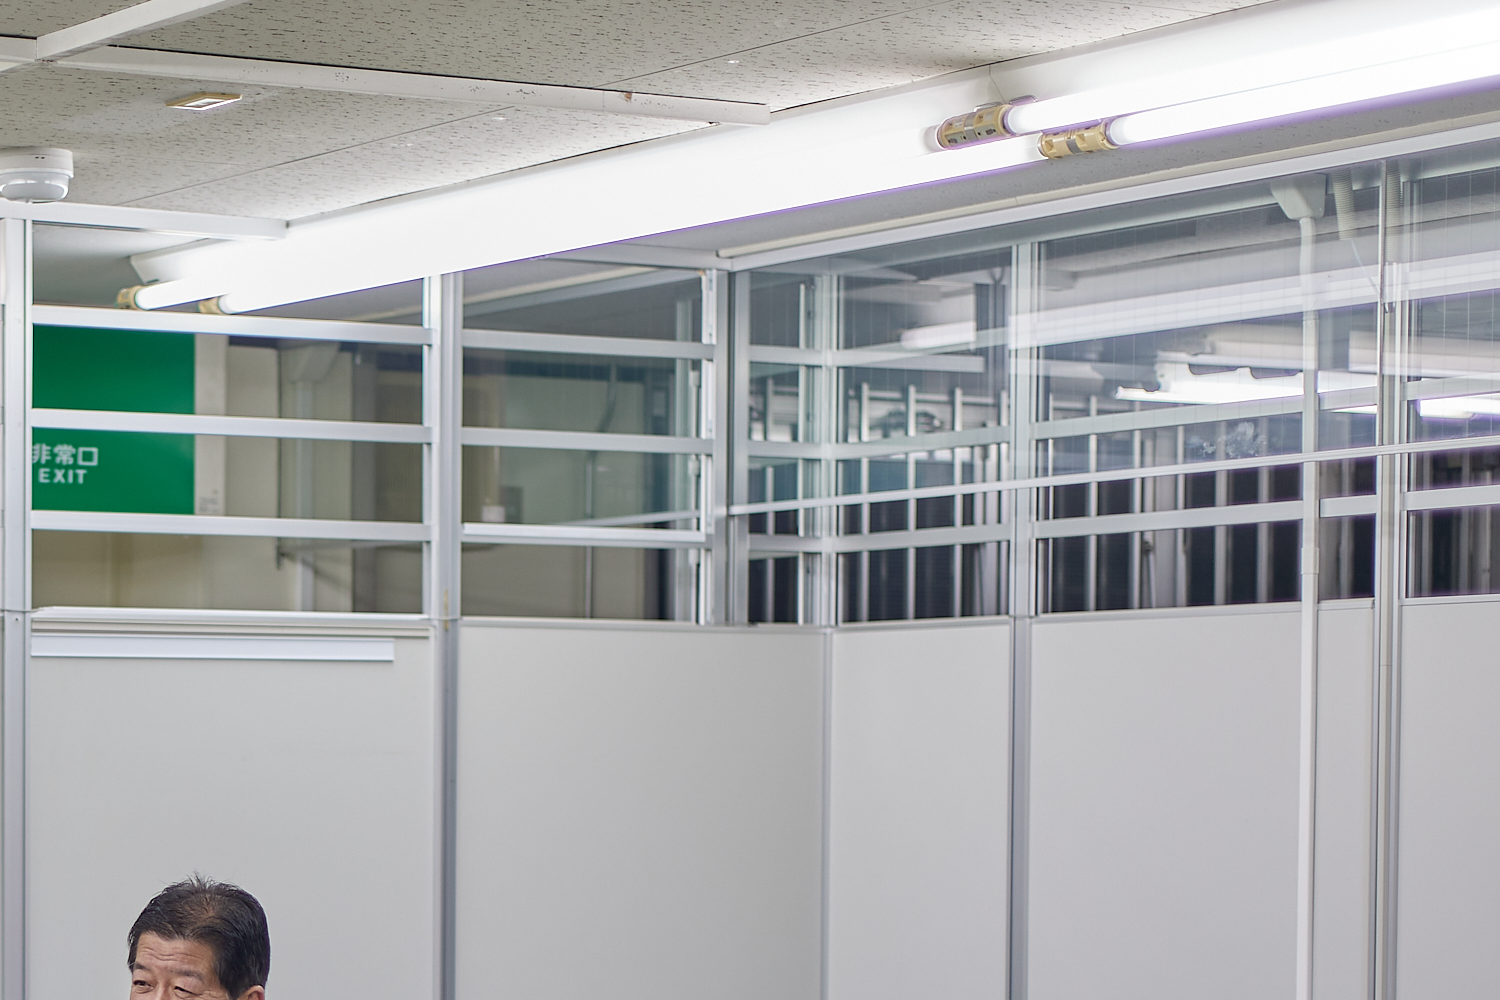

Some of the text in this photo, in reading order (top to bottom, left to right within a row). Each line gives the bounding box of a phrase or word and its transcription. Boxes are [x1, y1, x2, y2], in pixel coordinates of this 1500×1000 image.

[32, 443, 98, 466] 非常口
[38, 468, 87, 484] EXIT
